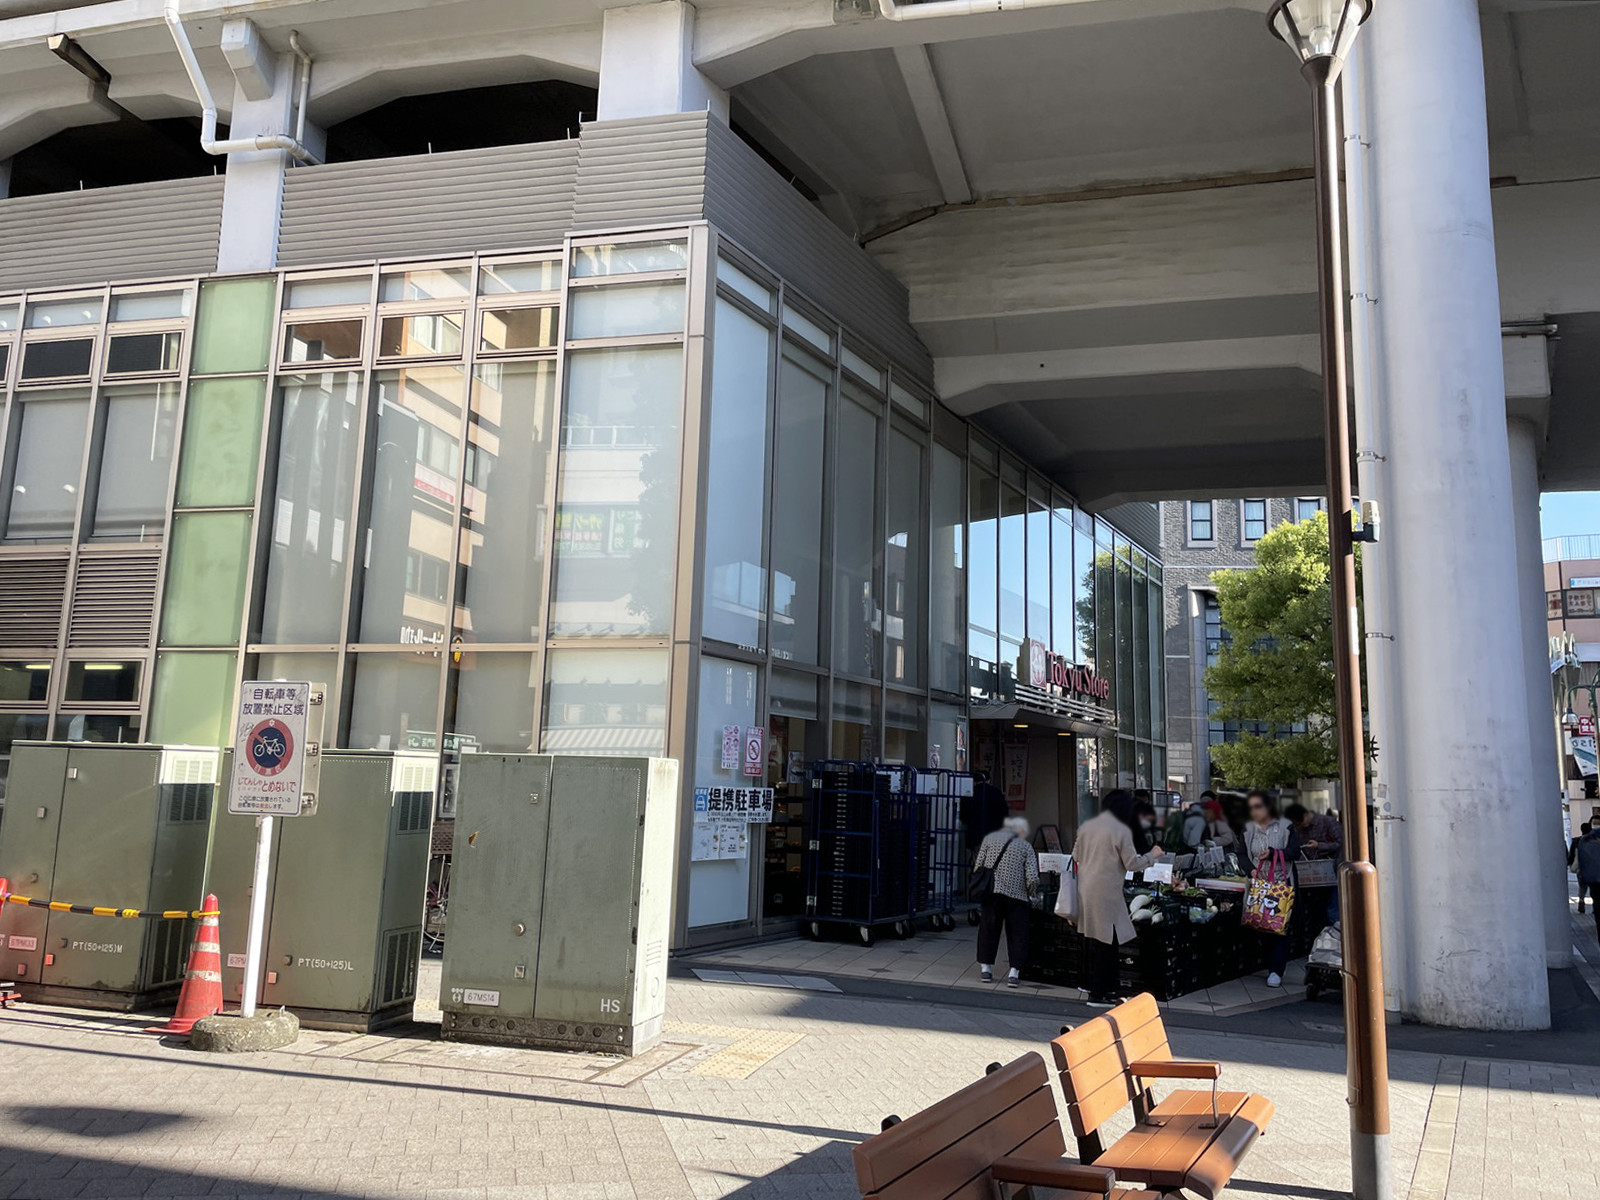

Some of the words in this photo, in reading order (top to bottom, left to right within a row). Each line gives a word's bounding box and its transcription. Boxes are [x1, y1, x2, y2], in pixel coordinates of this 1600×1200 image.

[1047, 651, 1082, 697] Tokyu
[1084, 665, 1110, 700] Store
[253, 688, 297, 701] 自転車等
[243, 703, 304, 716] 放置禁止区域
[708, 788, 773, 812] 提携駐車場
[467, 993, 495, 1003] 67MS14
[600, 998, 621, 1013] HS
